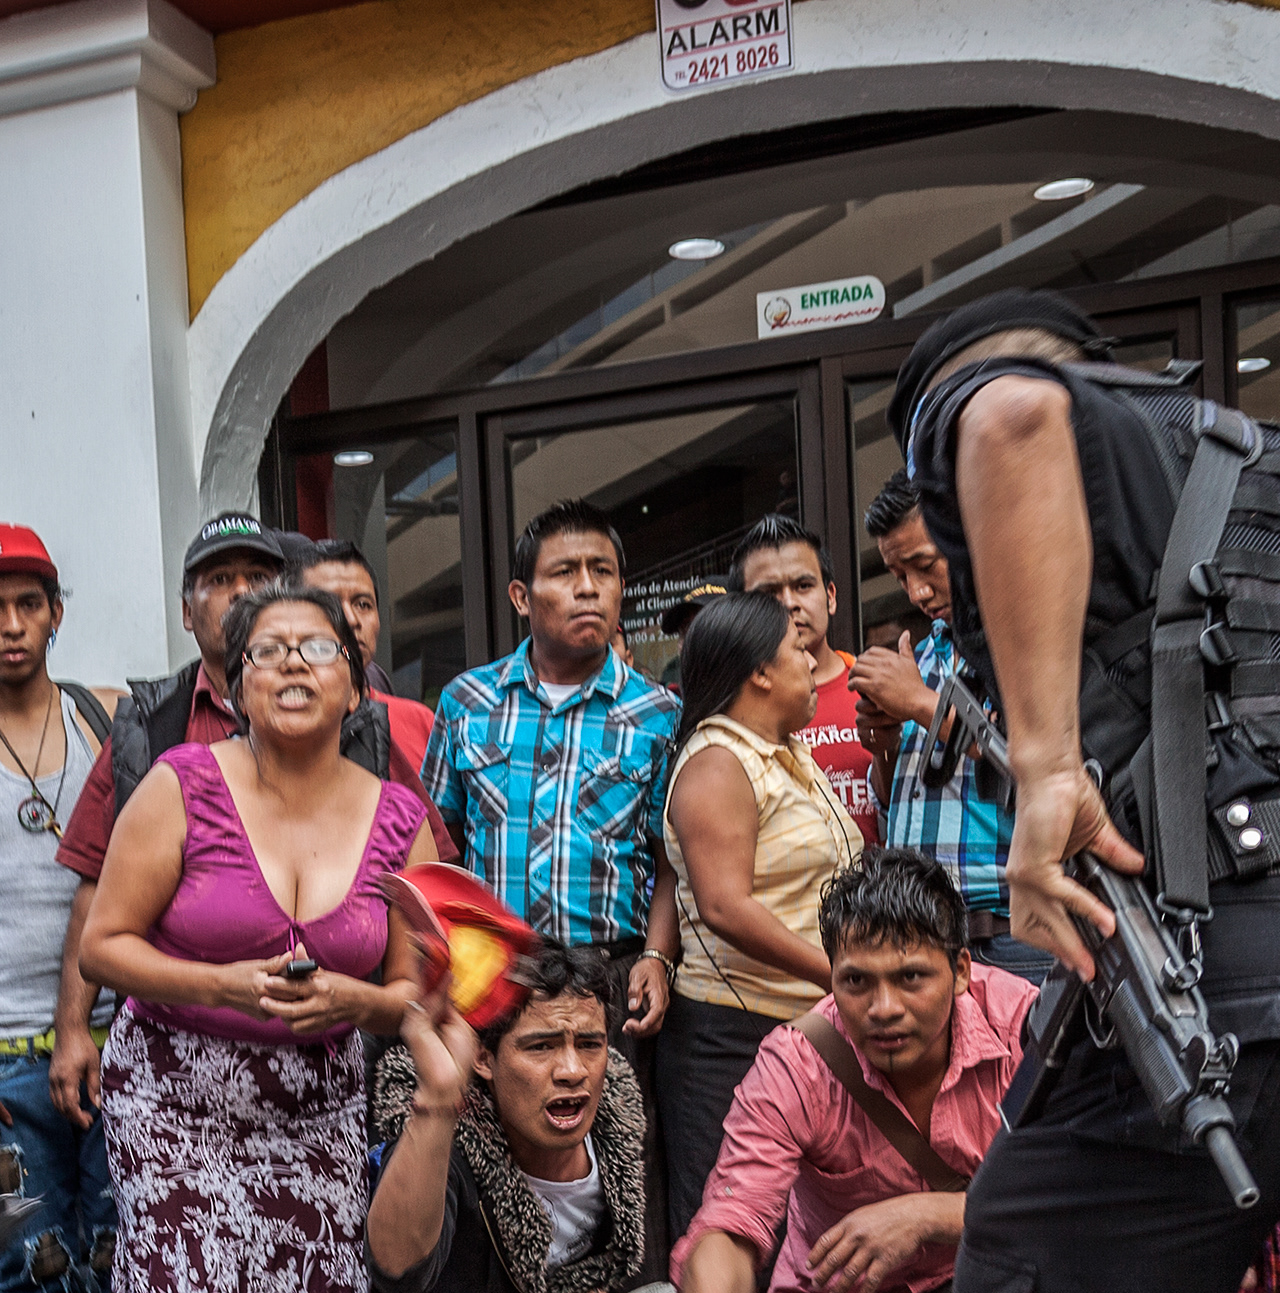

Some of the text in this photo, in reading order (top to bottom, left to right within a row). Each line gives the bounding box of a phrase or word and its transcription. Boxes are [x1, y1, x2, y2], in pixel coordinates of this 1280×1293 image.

[667, 8, 780, 56] ALARM
[688, 53, 729, 84] 2421
[736, 43, 779, 73] 8026
[801, 284, 873, 309] ENTRADA
[623, 575, 702, 597] rario de Atenció
[635, 595, 682, 613] al Cliente
[623, 616, 647, 631] unes
[649, 616, 655, 627] a
[626, 631, 648, 646] 0:00
